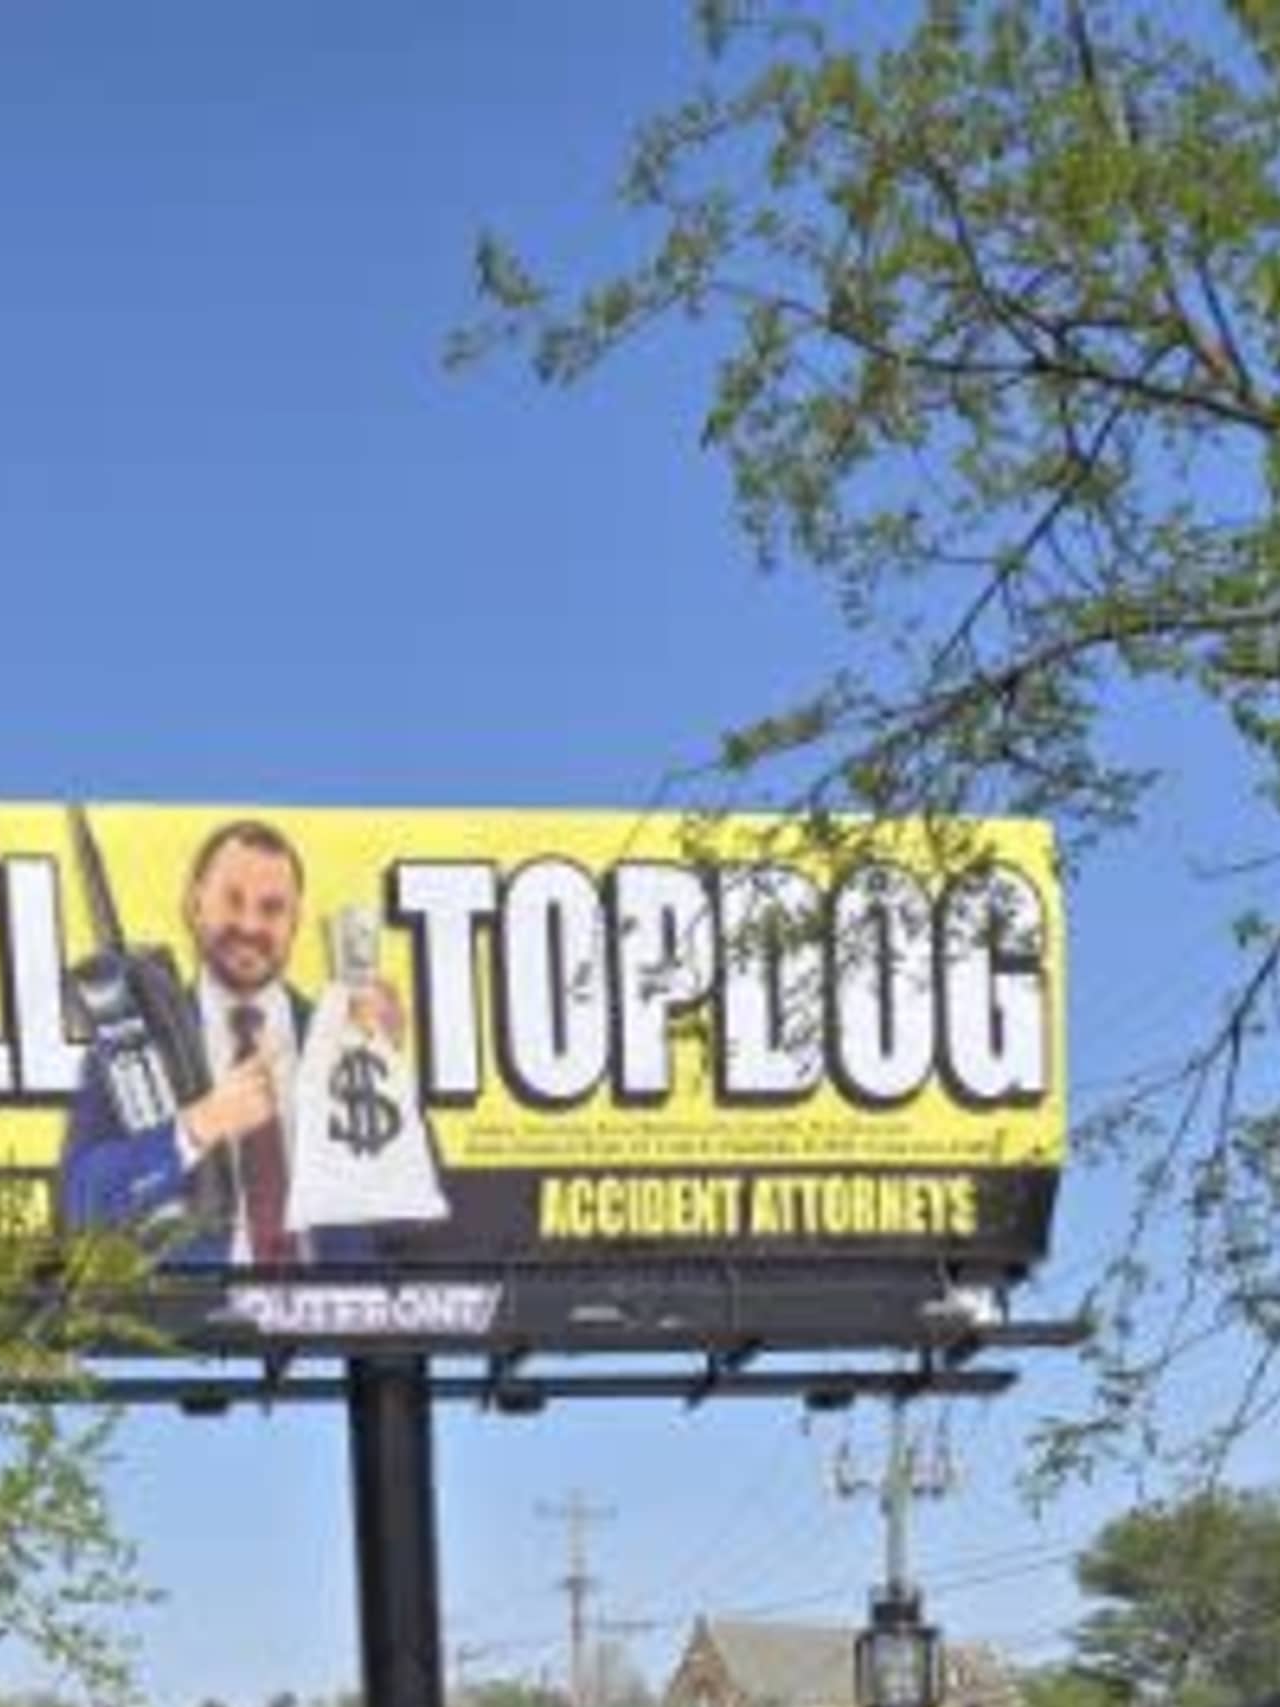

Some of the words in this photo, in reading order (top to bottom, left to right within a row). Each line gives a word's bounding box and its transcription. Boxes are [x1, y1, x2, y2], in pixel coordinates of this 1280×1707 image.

[328, 1048, 402, 1155] $
[539, 1177, 741, 1237] ACCIDENT
[750, 1174, 978, 1236] ATTORNEYS
